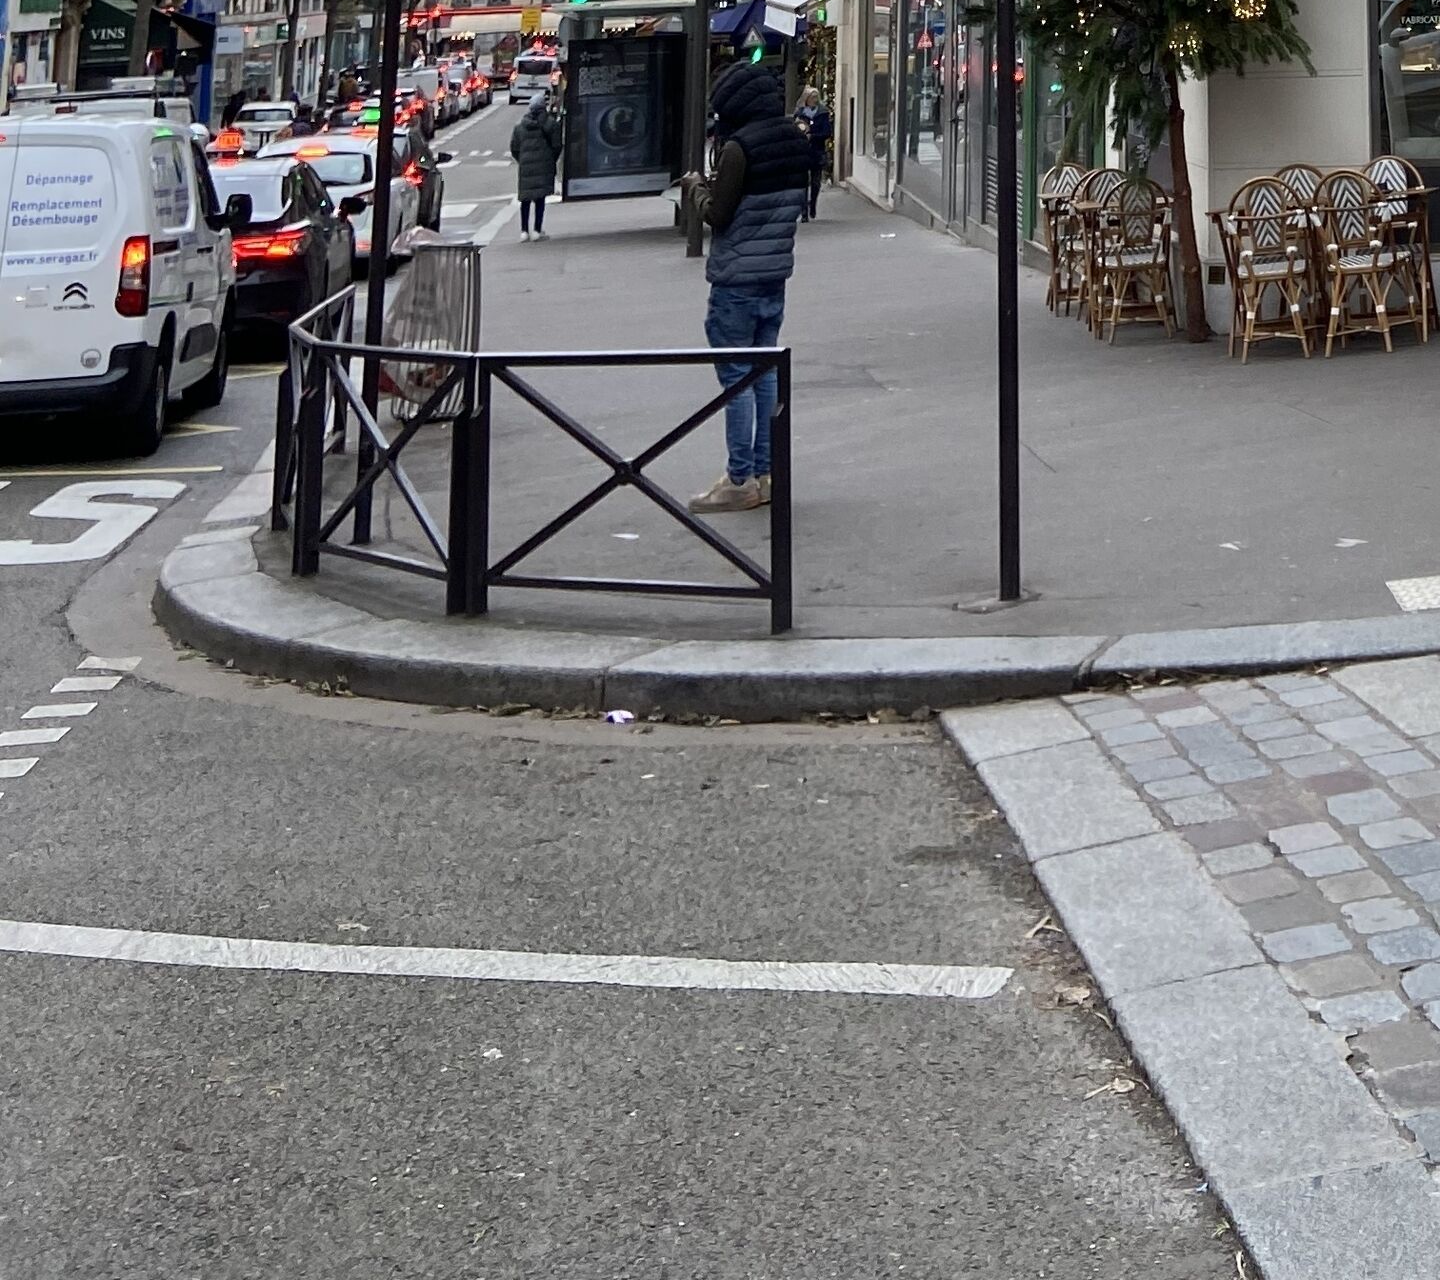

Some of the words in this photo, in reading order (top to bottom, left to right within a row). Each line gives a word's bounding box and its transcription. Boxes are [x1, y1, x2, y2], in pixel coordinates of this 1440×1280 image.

[90, 26, 126, 40] VINS
[26, 172, 94, 187] Dépannage
[11, 197, 103, 212] Remplacement
[12, 214, 99, 227] Désembouage
